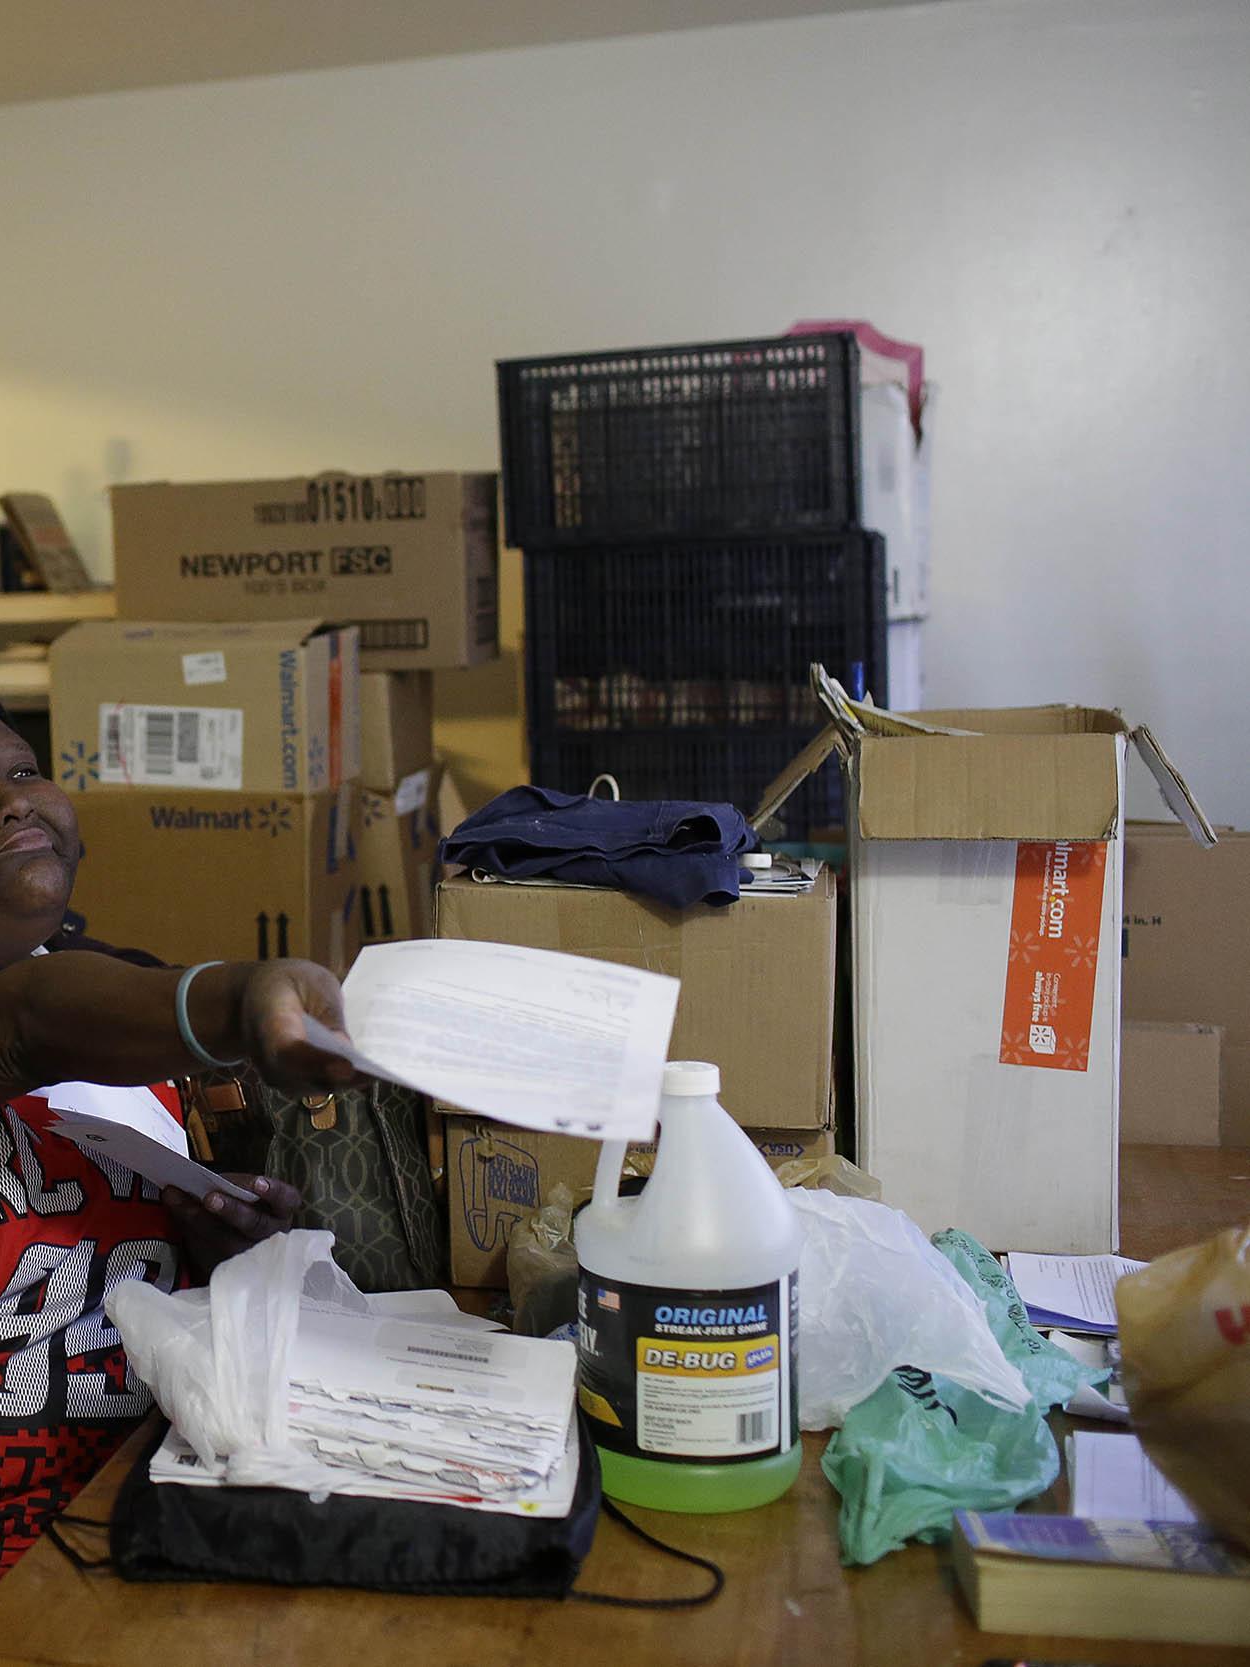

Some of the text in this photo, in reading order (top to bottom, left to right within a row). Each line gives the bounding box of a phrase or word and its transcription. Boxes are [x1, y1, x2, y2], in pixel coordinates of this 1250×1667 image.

[180, 547, 391, 579] NEWPORT FSC
[278, 649, 300, 789] Walmart.com
[150, 805, 253, 831] Walmart
[1030, 970, 1045, 1023] always free
[768, 1143, 794, 1153] USA
[654, 1304, 768, 1326] ORIGINAL
[654, 1321, 768, 1336] STREAK-FREE SHINE
[644, 1348, 737, 1370] DE-BUG
